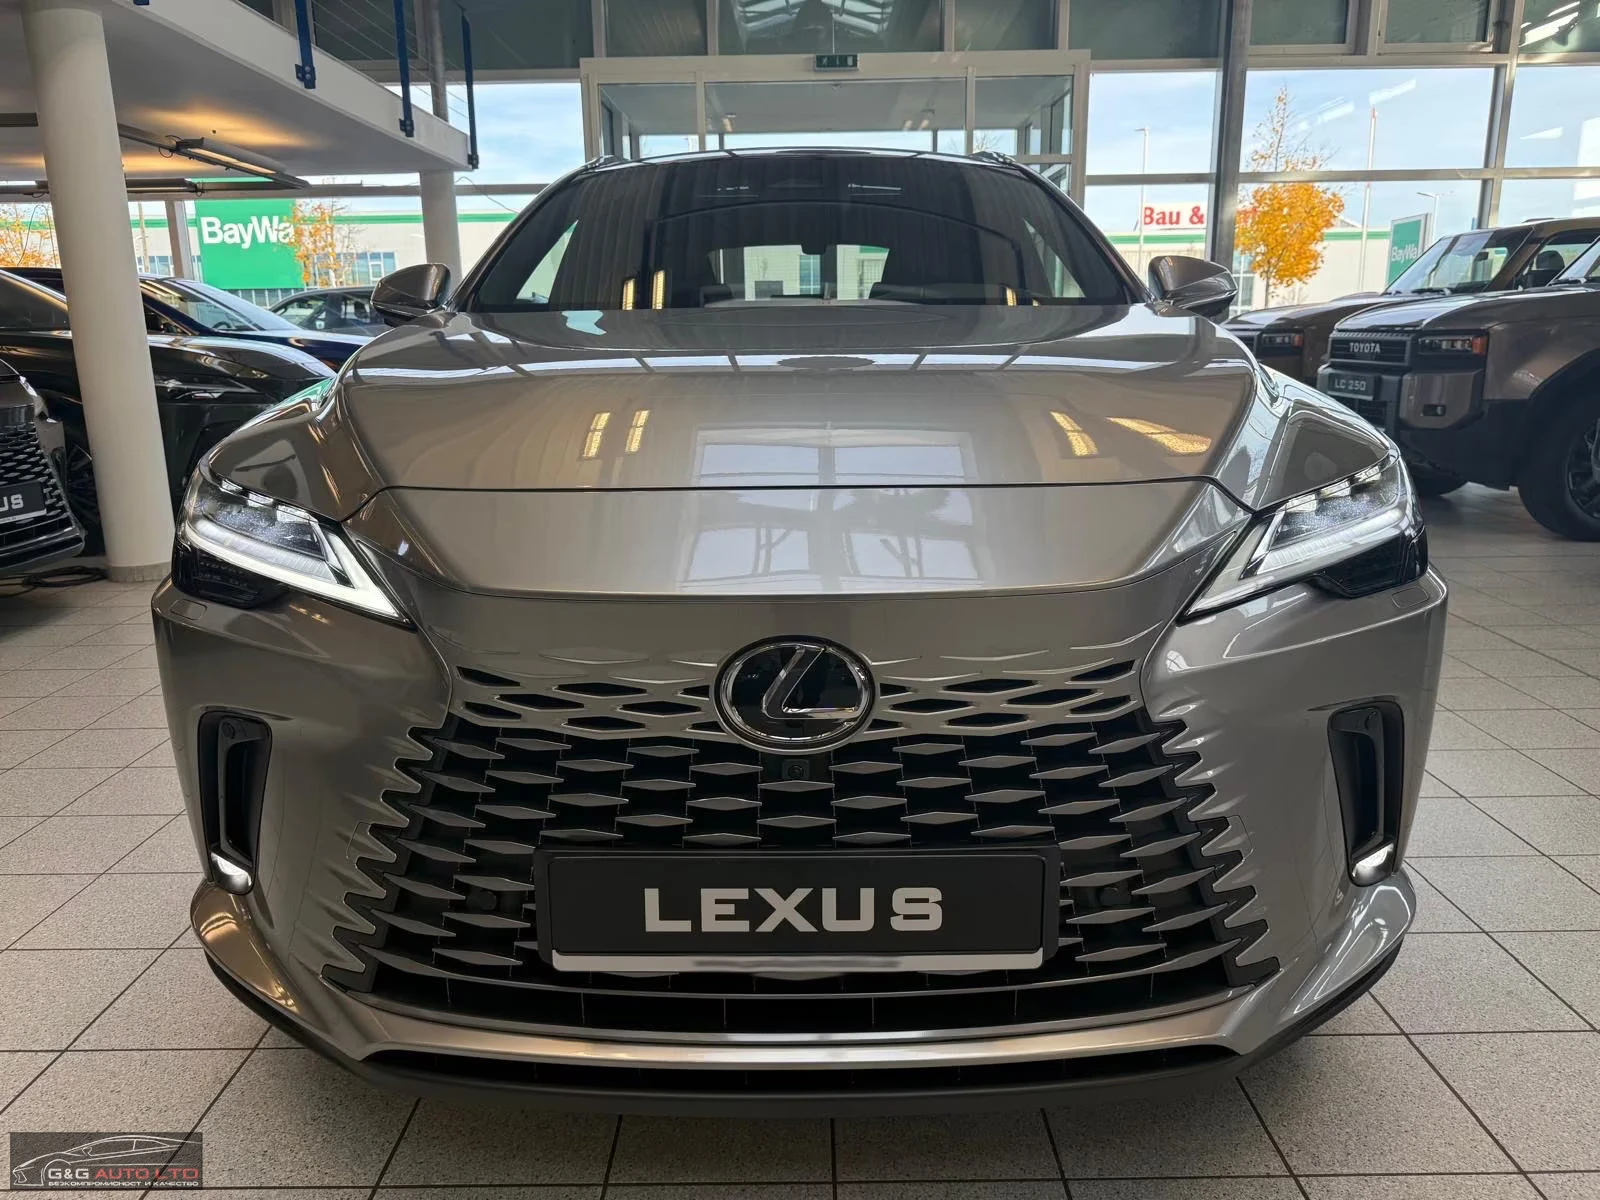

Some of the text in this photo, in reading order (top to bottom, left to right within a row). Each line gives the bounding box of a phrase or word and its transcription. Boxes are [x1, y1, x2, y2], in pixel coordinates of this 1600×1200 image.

[1143, 206, 1205, 226] Bau &
[200, 215, 295, 249] BayWa
[1391, 243, 1419, 264] BayWa
[1349, 342, 1381, 353] TOYOTA
[1334, 379, 1367, 391] LC 250
[644, 887, 943, 932] LEXUS
